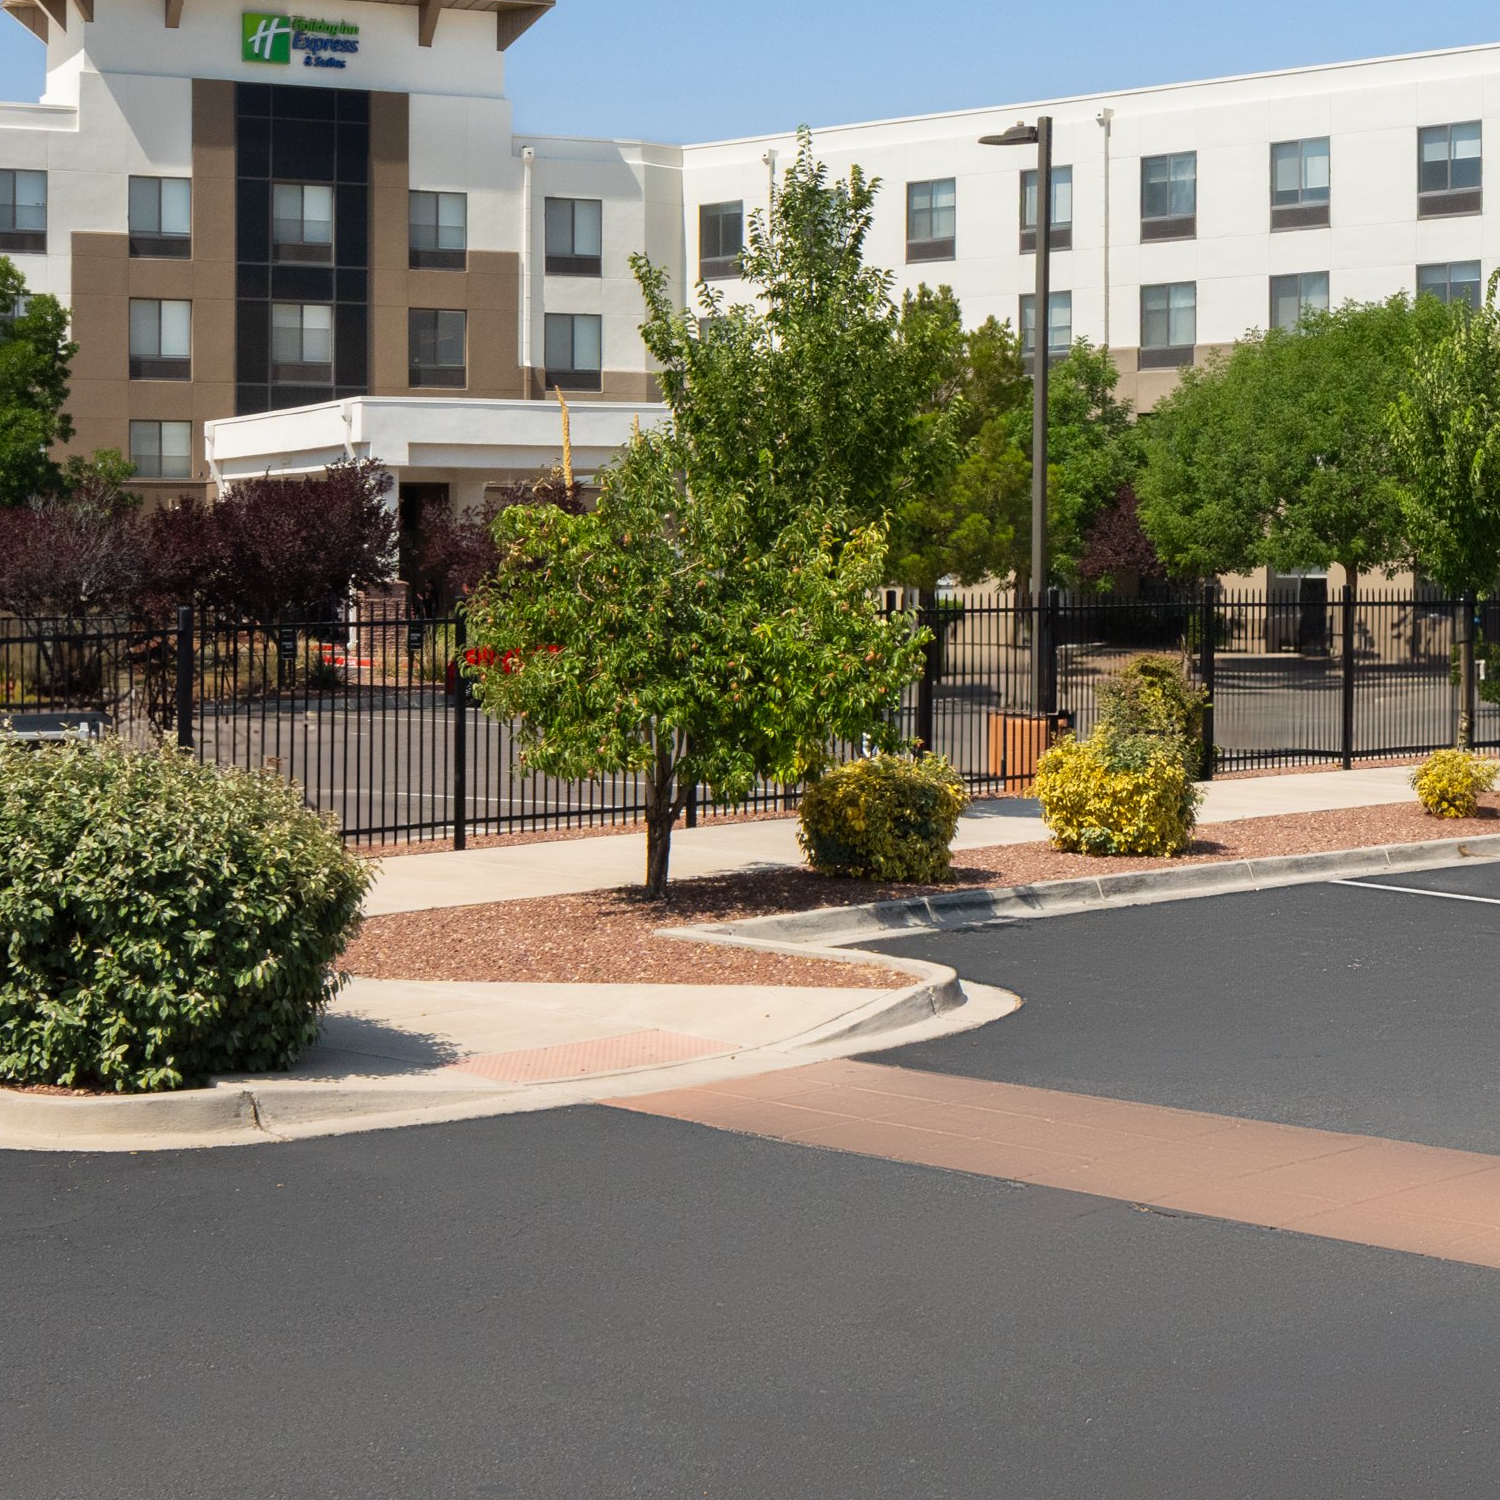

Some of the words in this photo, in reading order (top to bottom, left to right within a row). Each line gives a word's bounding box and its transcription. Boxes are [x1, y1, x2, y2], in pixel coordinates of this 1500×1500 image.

[291, 17, 338, 36] Holiday
[248, 18, 290, 59] H
[292, 32, 359, 55] Express
[303, 56, 312, 66] &
[313, 57, 346, 68] Suites
